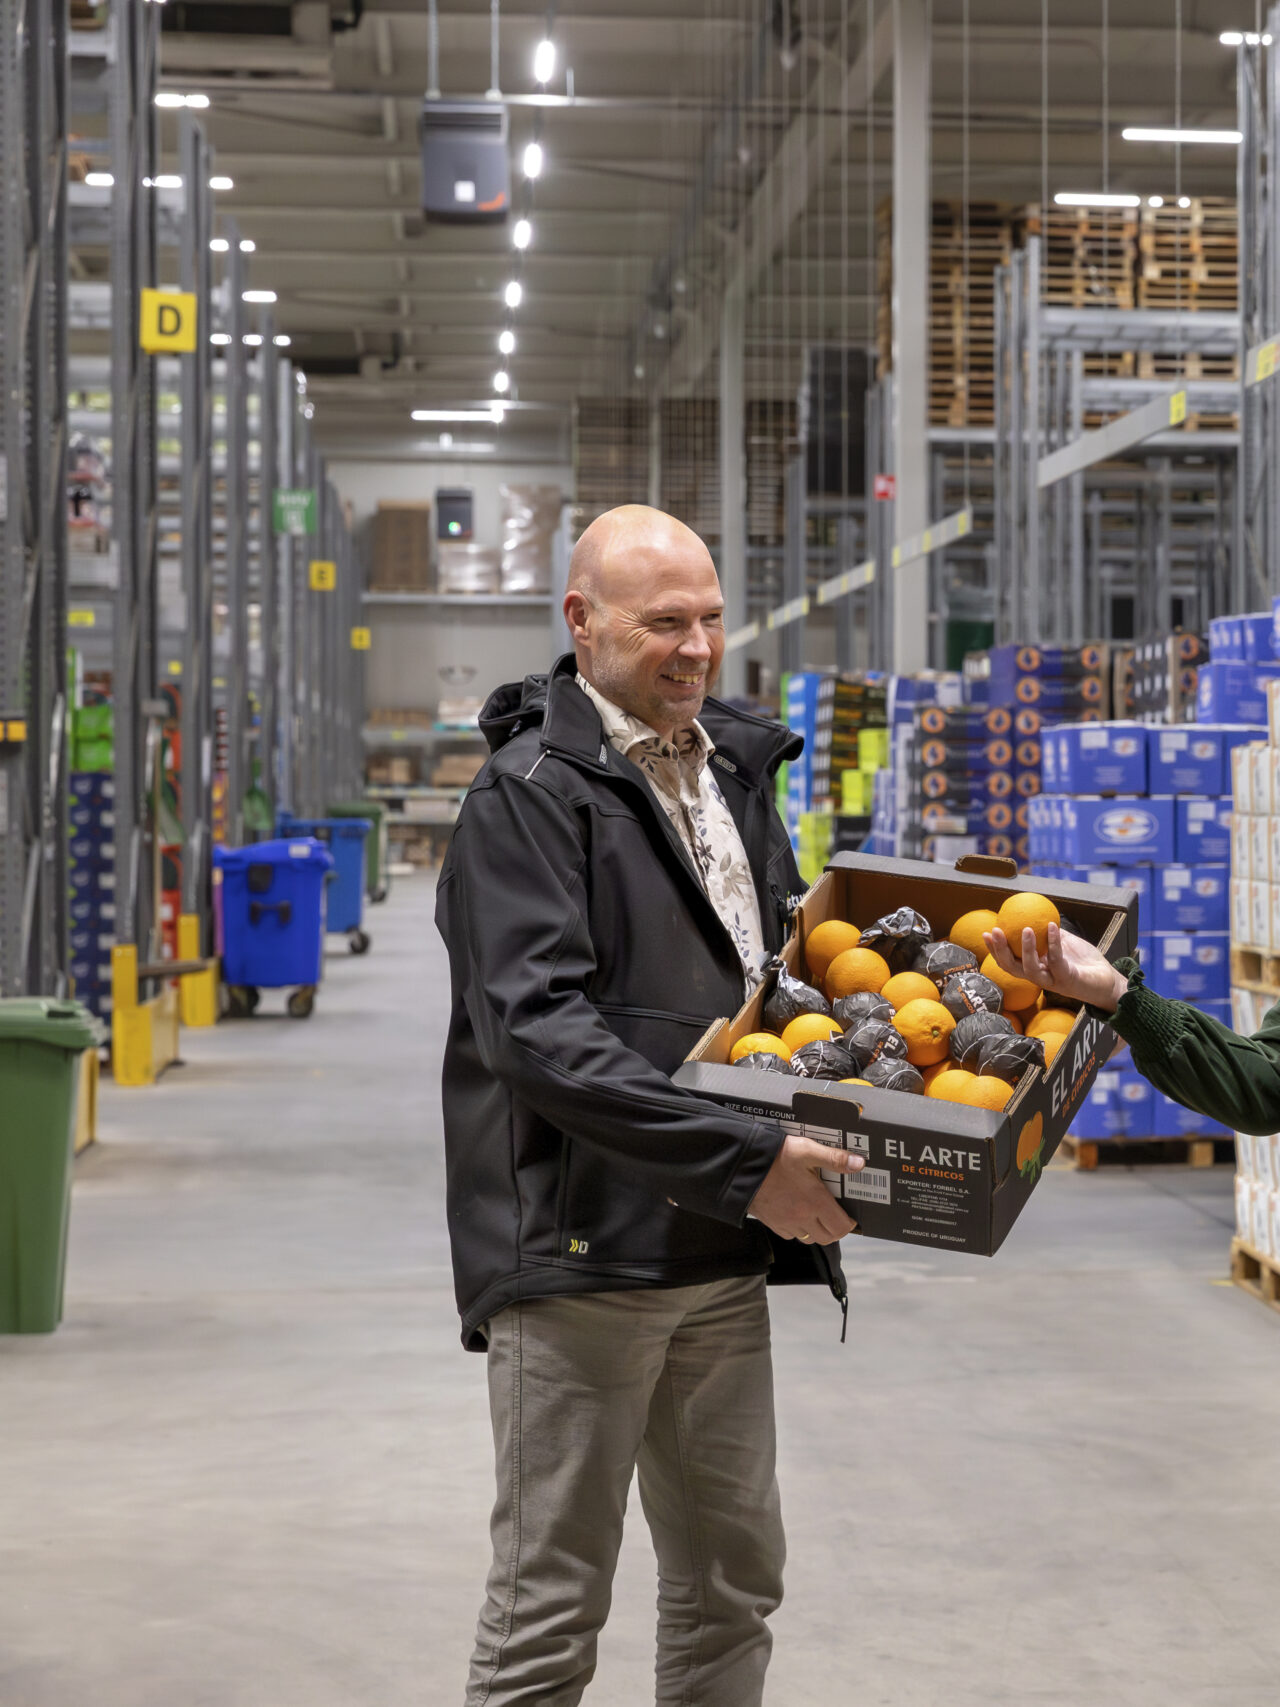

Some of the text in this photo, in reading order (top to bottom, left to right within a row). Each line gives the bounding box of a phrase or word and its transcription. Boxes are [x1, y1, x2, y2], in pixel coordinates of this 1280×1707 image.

[158, 303, 182, 337] D
[1052, 1067, 1067, 1118] EL
[724, 1102, 741, 1112] SIZE
[742, 1105, 764, 1116] OECD
[770, 1111, 795, 1120] COUNT
[885, 1139, 980, 1170] EL ARTE
[902, 1165, 964, 1180] DE CÍTRICOS
[897, 1178, 931, 1188] EXPORTER:
[933, 1184, 957, 1192] FORBEL
[903, 1229, 929, 1237] PRODUCE
